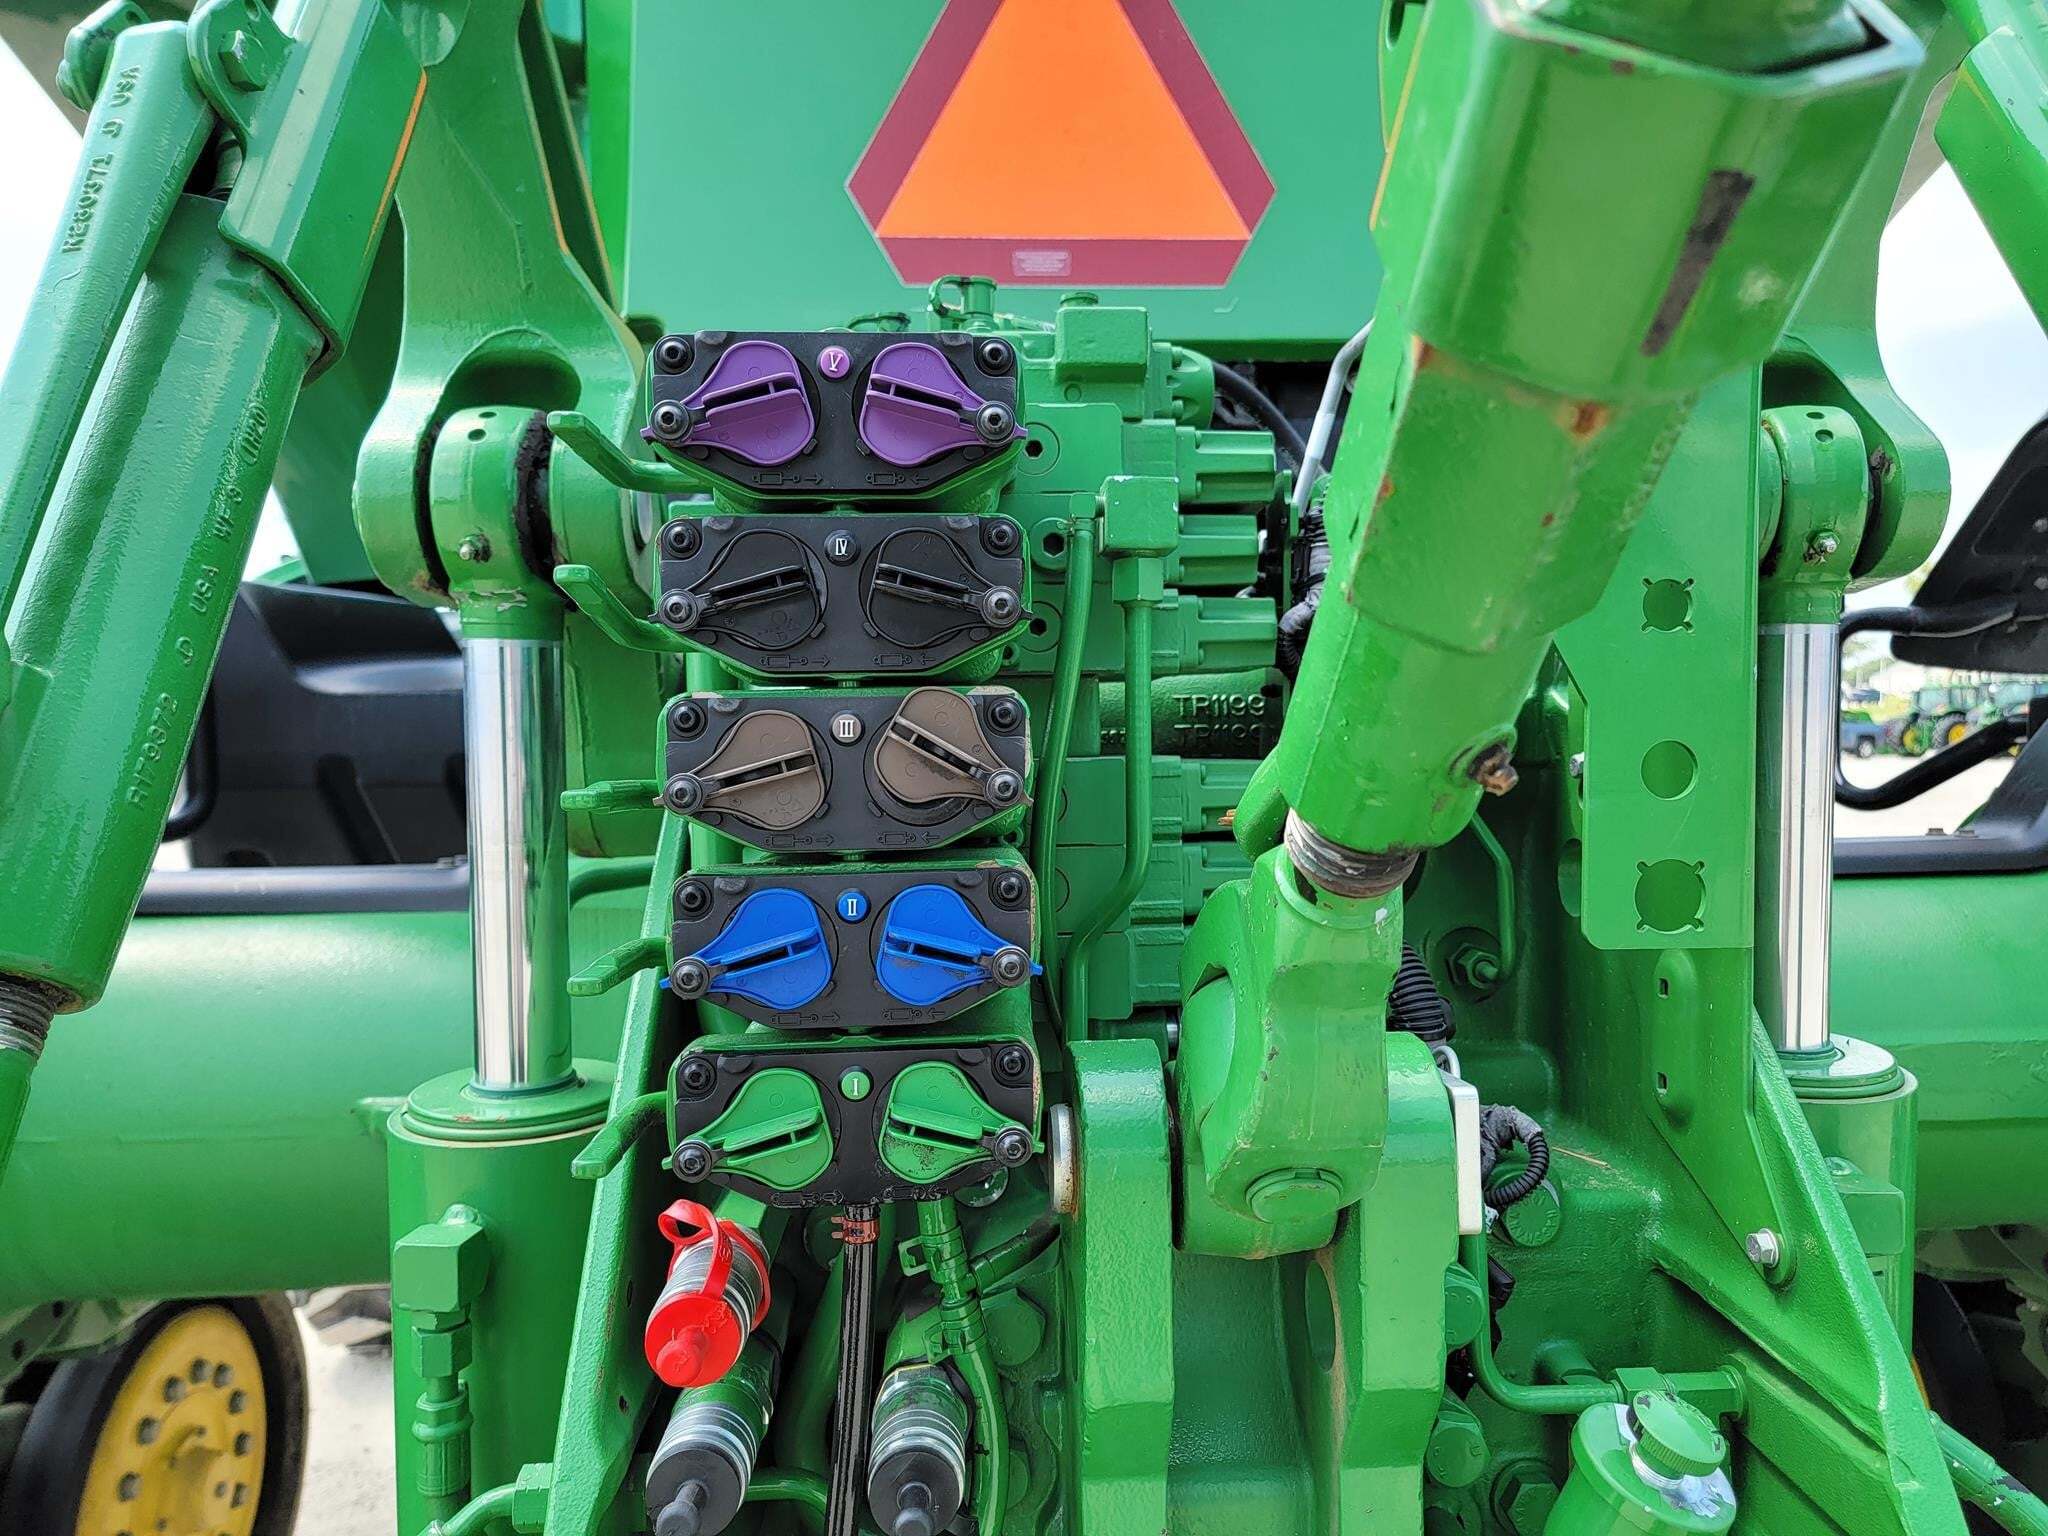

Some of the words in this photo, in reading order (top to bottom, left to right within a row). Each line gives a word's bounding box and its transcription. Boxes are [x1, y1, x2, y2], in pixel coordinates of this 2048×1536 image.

[829, 351, 844, 372] V
[835, 538, 848, 556] IV
[189, 565, 219, 614] USA
[839, 719, 855, 737] III
[847, 898, 857, 916] II
[852, 1077, 859, 1096] I
